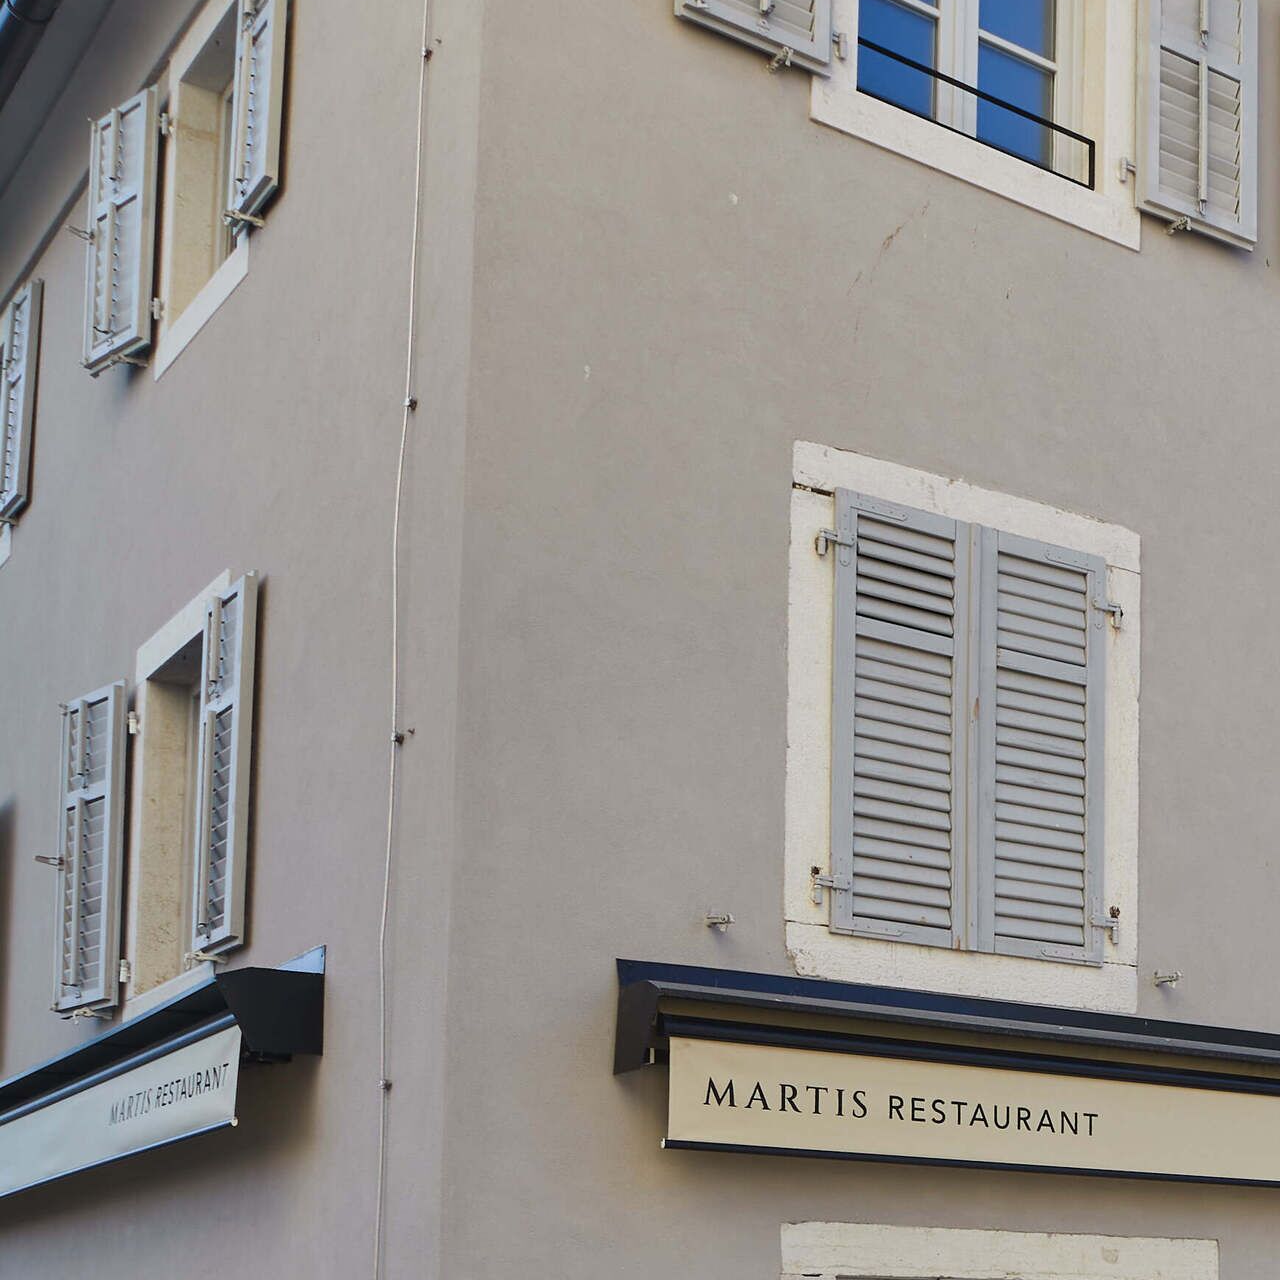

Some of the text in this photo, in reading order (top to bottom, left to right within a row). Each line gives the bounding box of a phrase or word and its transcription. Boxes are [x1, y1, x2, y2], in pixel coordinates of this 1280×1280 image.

[108, 1063, 229, 1125] MARTIS RESTAURANT
[702, 1076, 1099, 1136] MARTIS RESTAURANT
